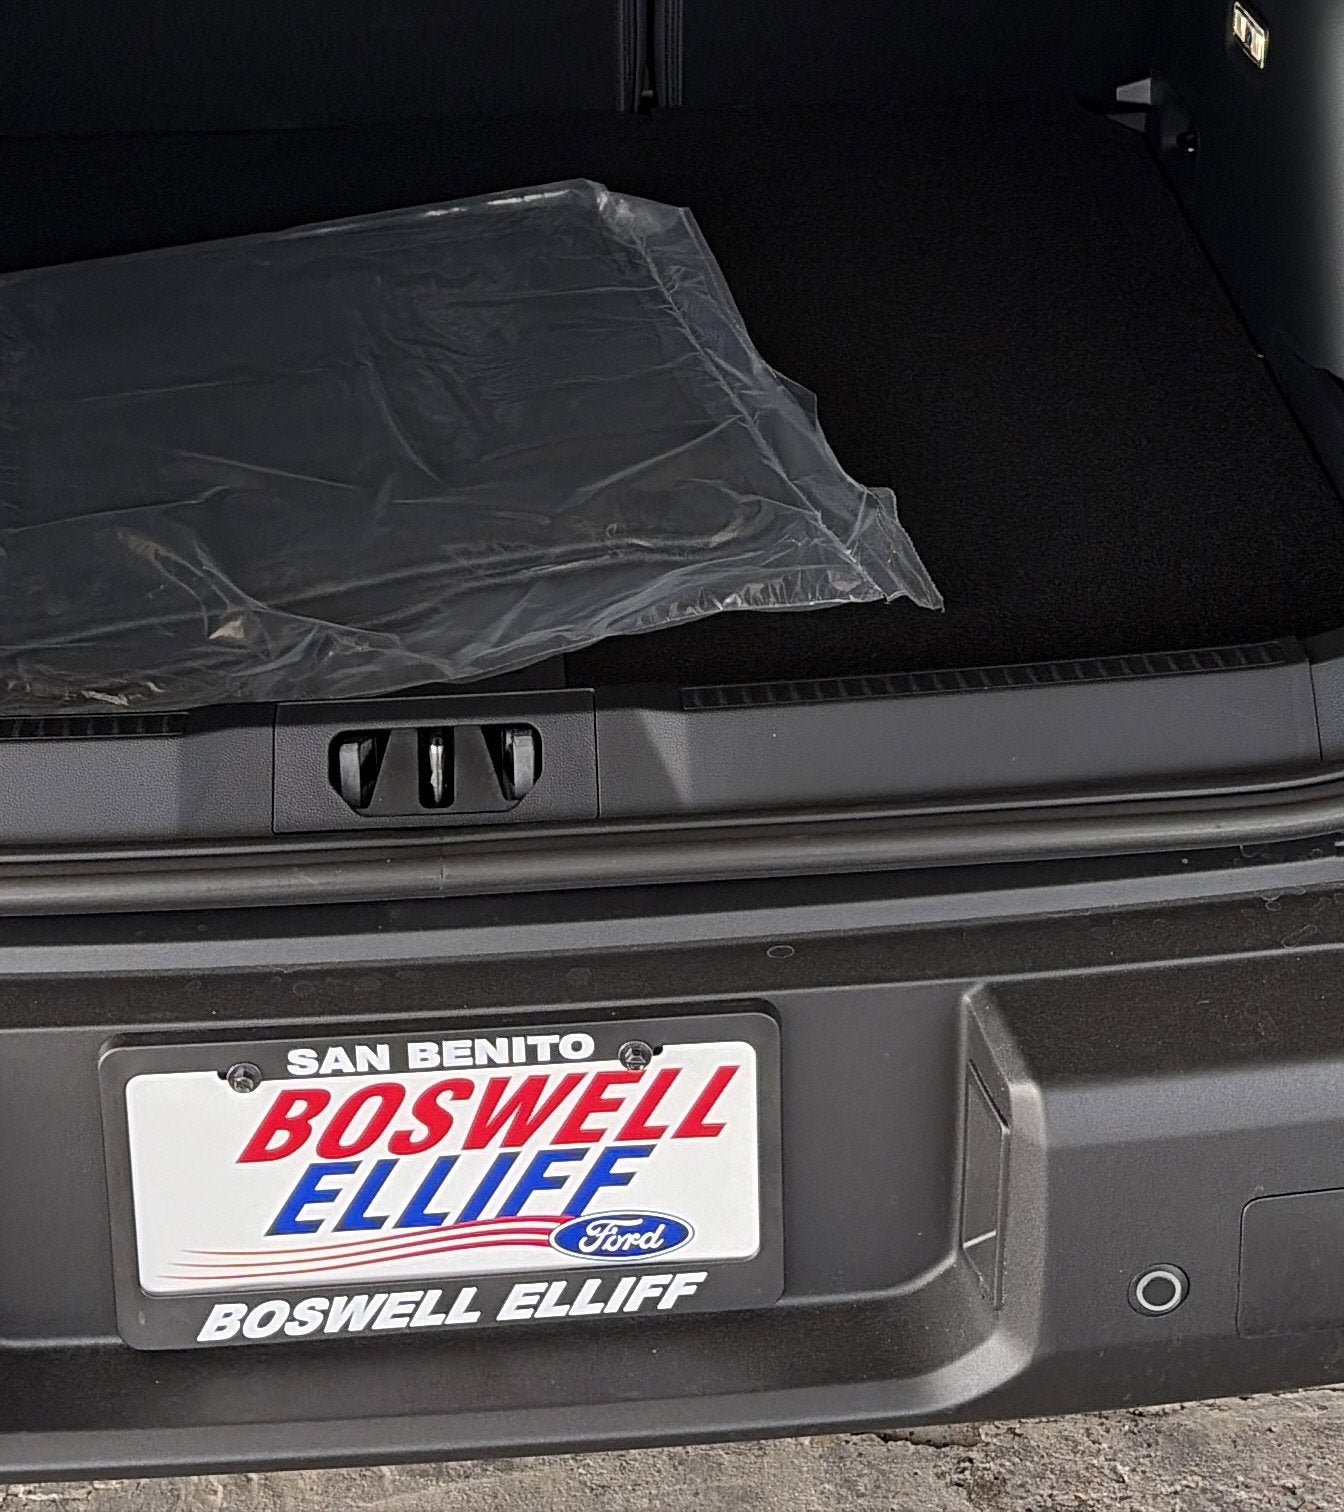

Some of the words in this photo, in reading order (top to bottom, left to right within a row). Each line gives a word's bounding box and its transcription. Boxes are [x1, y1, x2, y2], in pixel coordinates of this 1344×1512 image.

[287, 1044, 389, 1076] SAN
[407, 1034, 595, 1070] BENITO
[237, 1066, 740, 1164] BOSWELL
[264, 1143, 657, 1237] ELLIFF
[578, 1217, 665, 1256] Ford
[195, 1286, 481, 1342] BOSWELL
[497, 1272, 708, 1320] ELLIFF
